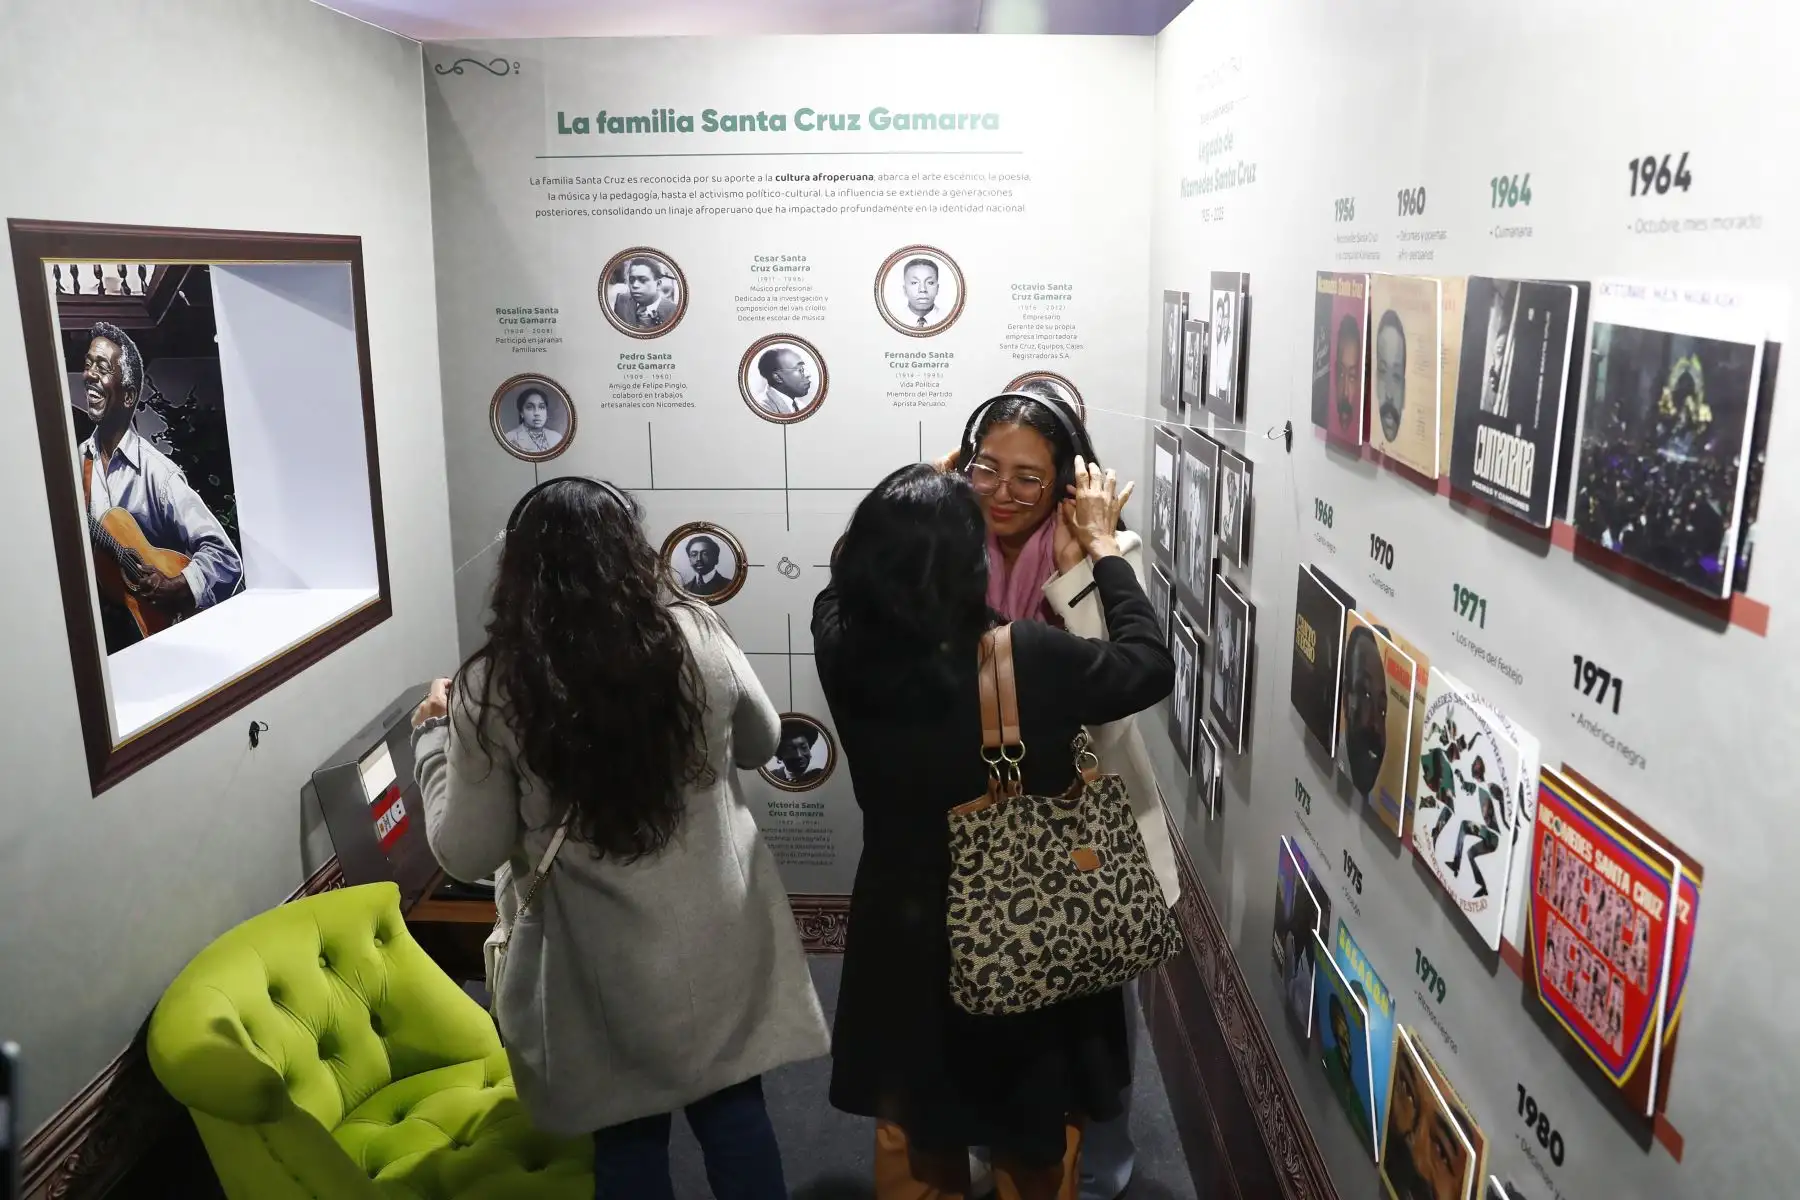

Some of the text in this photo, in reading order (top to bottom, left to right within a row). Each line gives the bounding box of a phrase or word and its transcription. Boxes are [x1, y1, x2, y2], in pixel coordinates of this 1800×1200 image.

[558, 106, 1000, 135] La familia Santa Cruz Gamarra
[1198, 125, 1234, 164] Legado de
[530, 176, 541, 186] La
[542, 176, 573, 185] familia
[575, 175, 601, 185] Santa
[604, 175, 625, 184] Cruz
[640, 175, 691, 184] reconocida
[693, 176, 708, 186] por
[724, 175, 755, 186] aporte
[765, 174, 773, 182] la
[775, 173, 810, 182] cultura
[812, 173, 876, 184] afroperuana,
[878, 173, 909, 181] abarca
[912, 173, 919, 181] el
[922, 173, 941, 181] arte
[988, 173, 996, 181] la
[1180, 159, 1257, 199] Nicomedes Santa Cruz
[1629, 151, 1692, 197] 1964
[548, 193, 556, 201] la
[558, 192, 590, 201] música
[592, 194, 597, 203] y
[600, 192, 607, 200] la
[610, 191, 660, 203] pedagogía,
[661, 191, 687, 199] hasta
[689, 191, 696, 199] el
[699, 191, 744, 199] activismo
[825, 189, 836, 197] La
[838, 189, 884, 197] influencia
[899, 189, 940, 197] extiende
[950, 189, 1013, 199] generaciones
[1397, 186, 1426, 216] 1960
[1490, 172, 1531, 208] 1964
[536, 208, 589, 218] posteriores,
[592, 207, 652, 216] consolidando
[669, 206, 693, 217] linaje
[695, 205, 753, 217] afroperuano
[755, 207, 773, 217] que
[775, 205, 786, 213] ha
[788, 204, 838, 216] impactado
[840, 204, 913, 216] profundamente
[929, 204, 938, 212] la
[940, 204, 984, 212] identidad
[1335, 197, 1355, 222] 1956
[754, 254, 807, 262] Cesar Santa
[1011, 283, 1073, 291] Octavio Santa
[1012, 293, 1072, 301] Cruz Gamarra
[496, 306, 559, 315] Rosalina Santa
[499, 316, 557, 325] Cruz Gamarra
[496, 336, 526, 345] Participó
[538, 337, 563, 345] jaranas
[1054, 323, 1076, 331] propia
[617, 362, 676, 370] Cruz Gamarra
[620, 352, 672, 361] Pedro Santa
[884, 351, 954, 359] Fernando Santa
[889, 361, 949, 369] Cruz Gamarra
[609, 382, 630, 391] Amigo
[643, 382, 663, 391] Felipe
[654, 391, 683, 400] trabajos
[1315, 497, 1333, 529] 1968
[1370, 533, 1394, 570] 1970
[1453, 583, 1486, 629] 1971
[1456, 630, 1467, 647] Los
[1467, 640, 1485, 661] reyes
[1486, 652, 1498, 667] del
[1573, 655, 1623, 715] 1971
[1577, 712, 1647, 770] América negra
[1295, 777, 1311, 815] 1973
[1343, 849, 1363, 895] 1975
[1538, 803, 1593, 863] NICOMEDES
[1594, 850, 1630, 894] SANTA
[1632, 880, 1664, 922] CRUZ
[1537, 830, 1650, 996] AMERICA
[1415, 948, 1446, 1004] 1979
[1517, 1082, 1564, 1168] 1980
